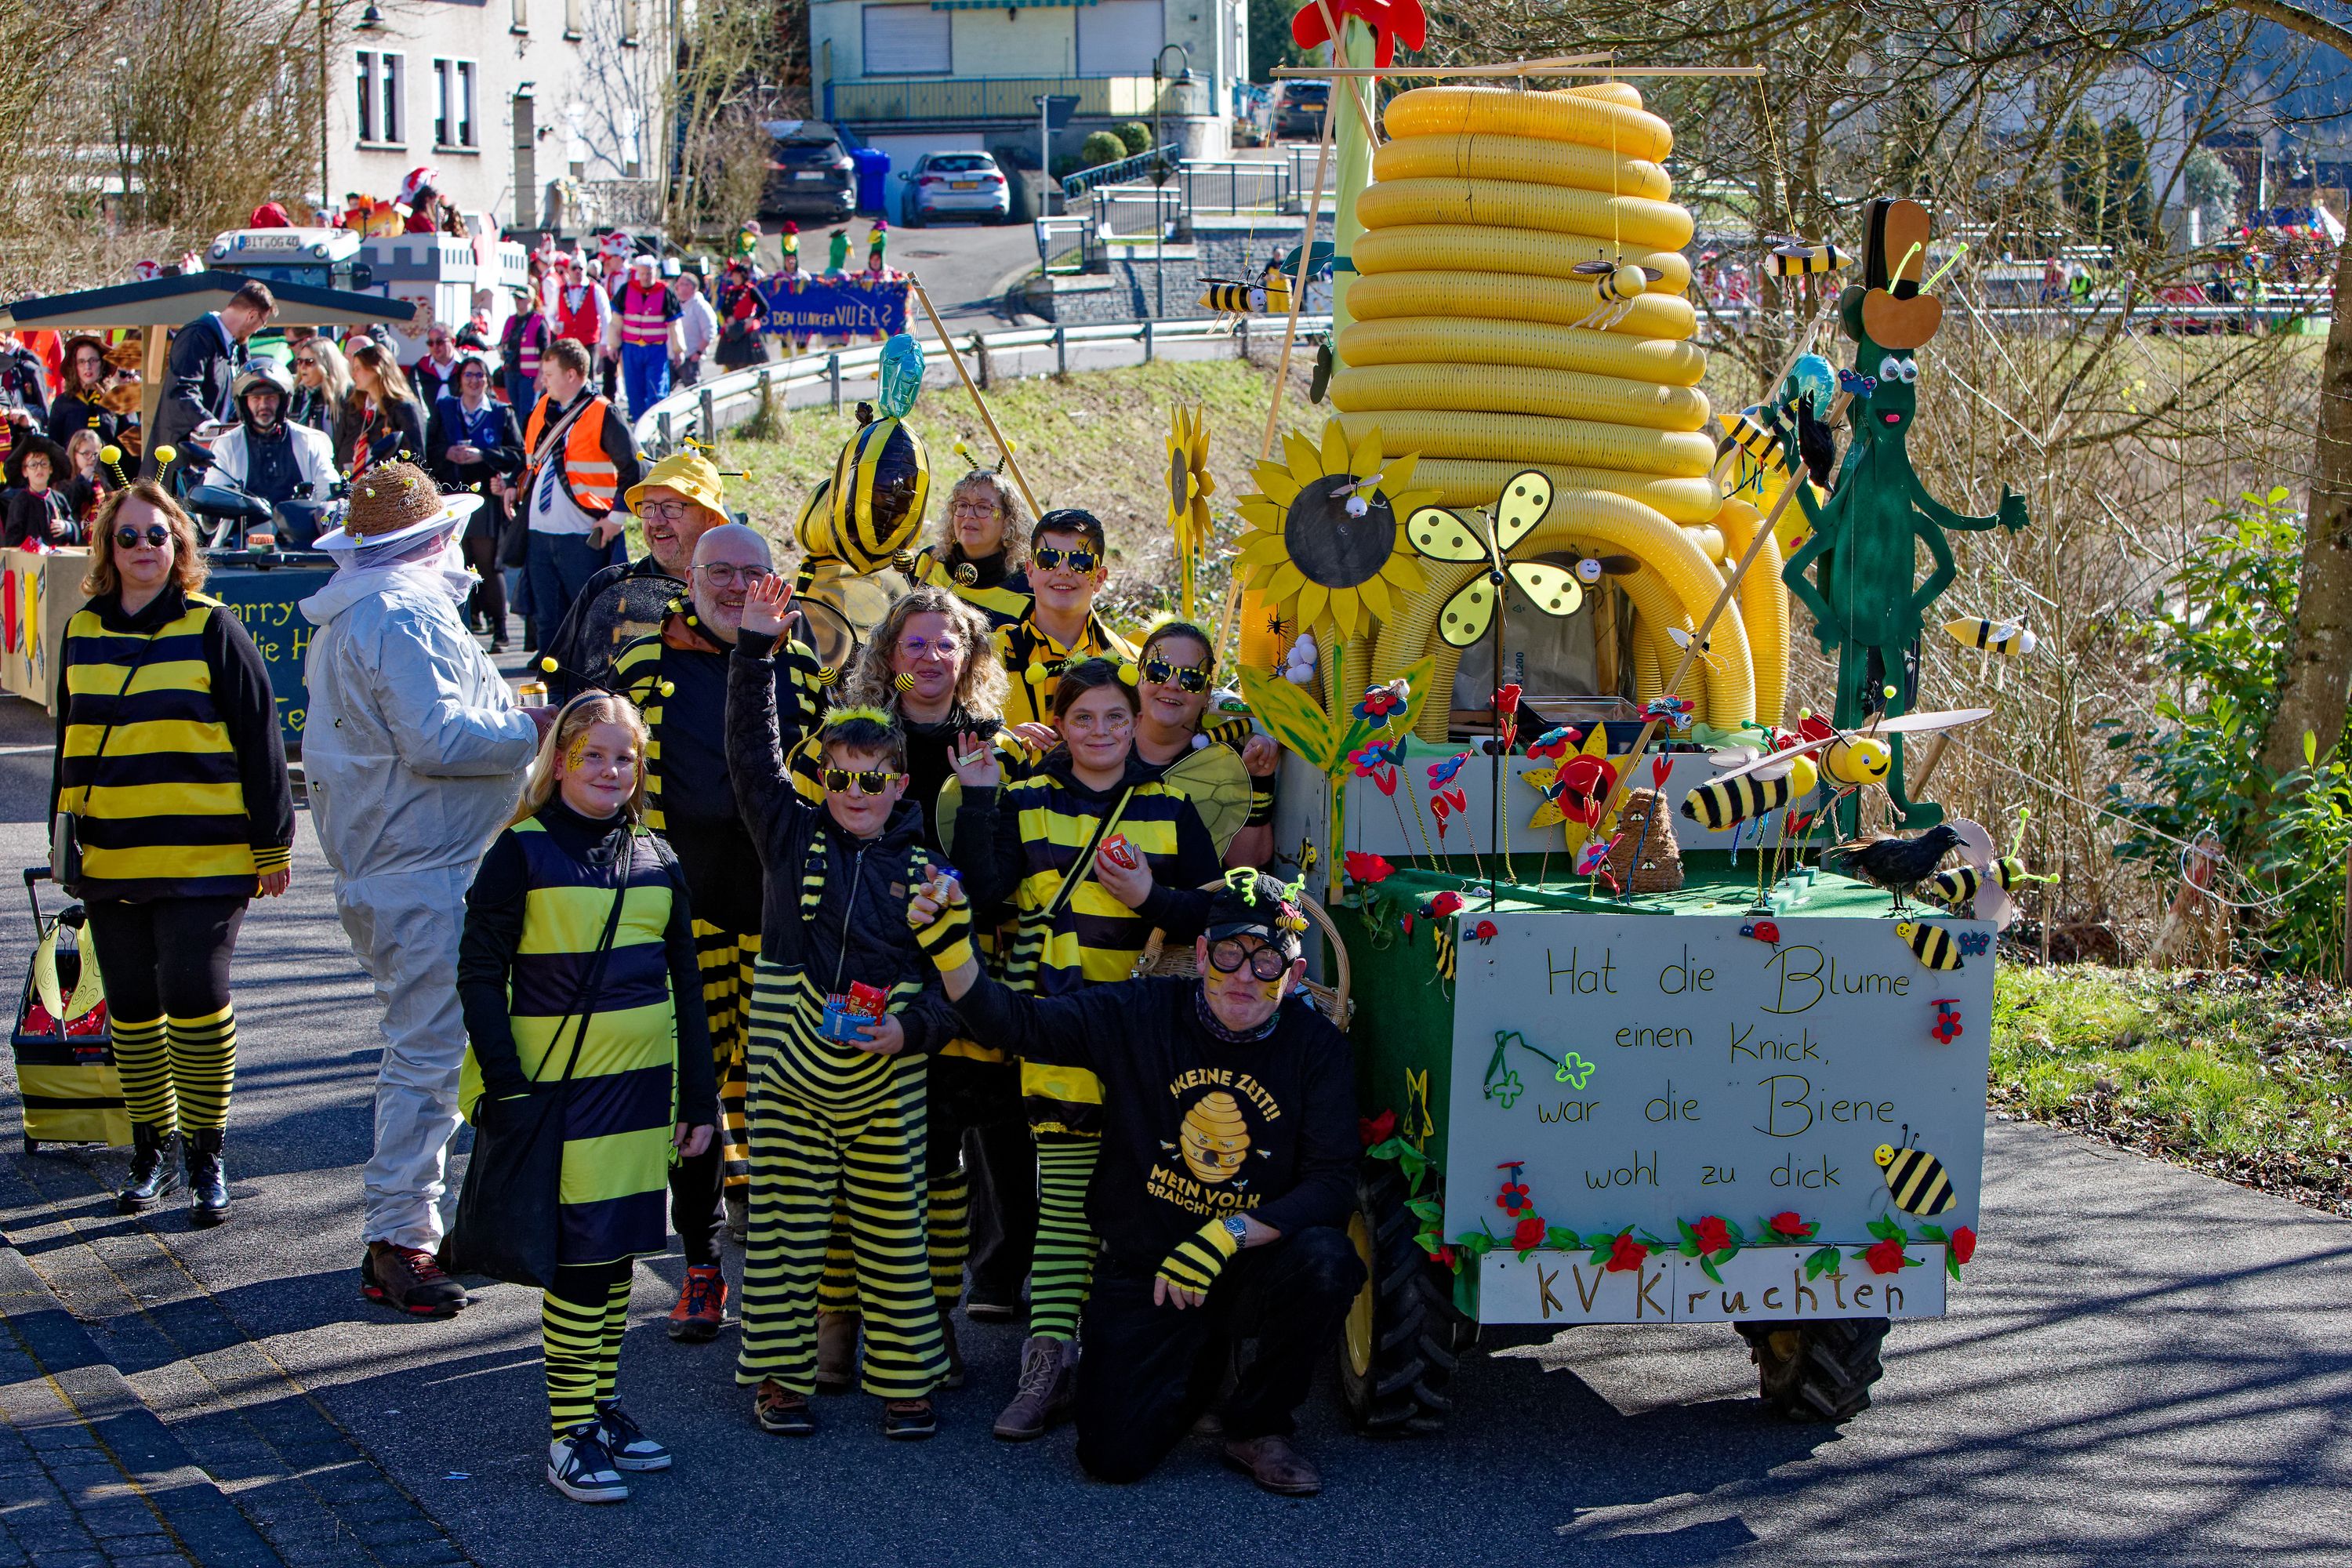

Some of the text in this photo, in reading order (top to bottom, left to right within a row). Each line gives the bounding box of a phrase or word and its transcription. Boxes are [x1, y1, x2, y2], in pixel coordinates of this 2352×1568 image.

[245, 237, 264, 247] BIT
[1547, 943, 1910, 1014] Hat die Blume
[1615, 1022, 1829, 1065] einen Knick,
[1235, 1073, 1281, 1122] ZEIT!!
[1538, 1074, 1894, 1138] war die Biene
[1149, 1163, 1261, 1209] MEIN VOLK
[1585, 1149, 1841, 1189] wohl zu dick
[1146, 1181, 1213, 1215] BRAUCHT
[1537, 1262, 1904, 1319] KV Kruchten
